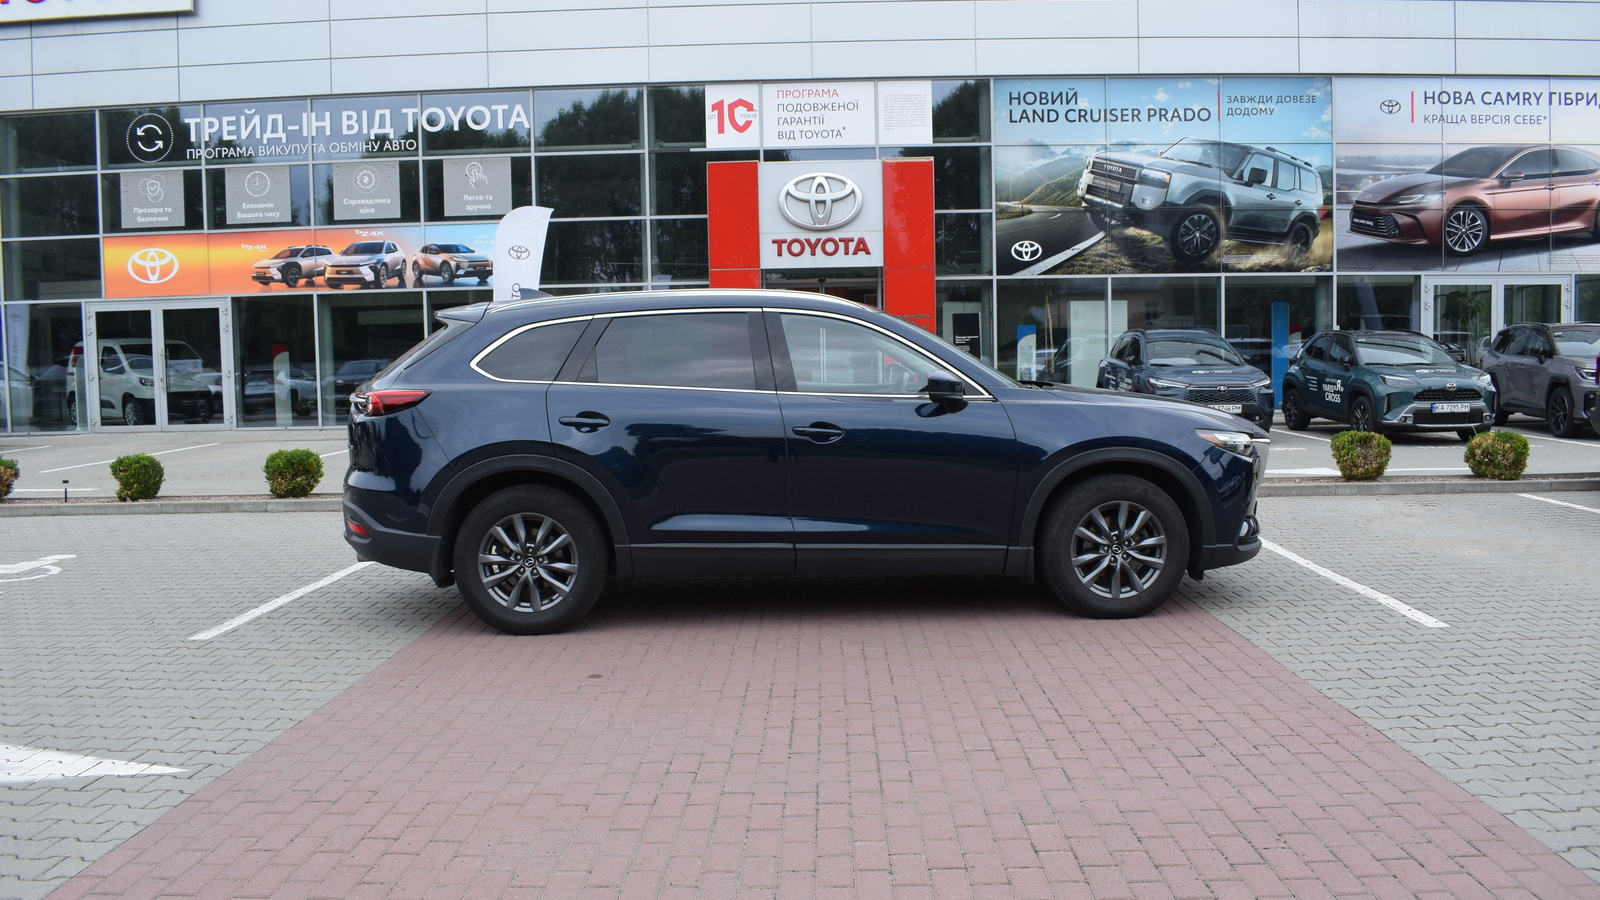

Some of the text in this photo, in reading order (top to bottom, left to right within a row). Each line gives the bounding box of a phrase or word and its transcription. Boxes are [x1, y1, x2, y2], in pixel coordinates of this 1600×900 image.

[777, 89, 839, 99] ПРОГРАМА
[1008, 88, 1079, 106] НОВИЙ
[1226, 95, 1317, 104] ЗАВЖДИ ДОВЕЗЕ
[1424, 90, 1600, 109] НОВА CAMRY ГІБРИ
[777, 99, 859, 113] ПОДОВЖЕНОЇ
[1008, 108, 1212, 123] LAND CRUISER PRADO
[1226, 107, 1275, 117] ДОДОМУ
[184, 104, 530, 144] ТРЕЙД-ІН ВІД TOYOTA
[777, 114, 825, 126] ГАРАНТІЇ
[1424, 114, 1467, 125] КРАЩА
[1471, 114, 1510, 125] ВЕРСІЯ
[777, 131, 797, 141] ВІД
[186, 139, 417, 160] ПРОГРАМА ВИКУПУ ТА ОБМІНУ АВТО
[1104, 164, 1122, 172] TOYOTA
[343, 197, 391, 206] Справедлива
[463, 194, 482, 202] Легко
[133, 206, 162, 215] Прозоро
[242, 201, 274, 210] Економія
[359, 206, 375, 215] ціна
[465, 203, 492, 211] зручно
[136, 214, 169, 223] безпечно
[237, 211, 262, 219] Вашого
[771, 236, 872, 258] TOYOTA
[1325, 392, 1341, 403] CROSS
